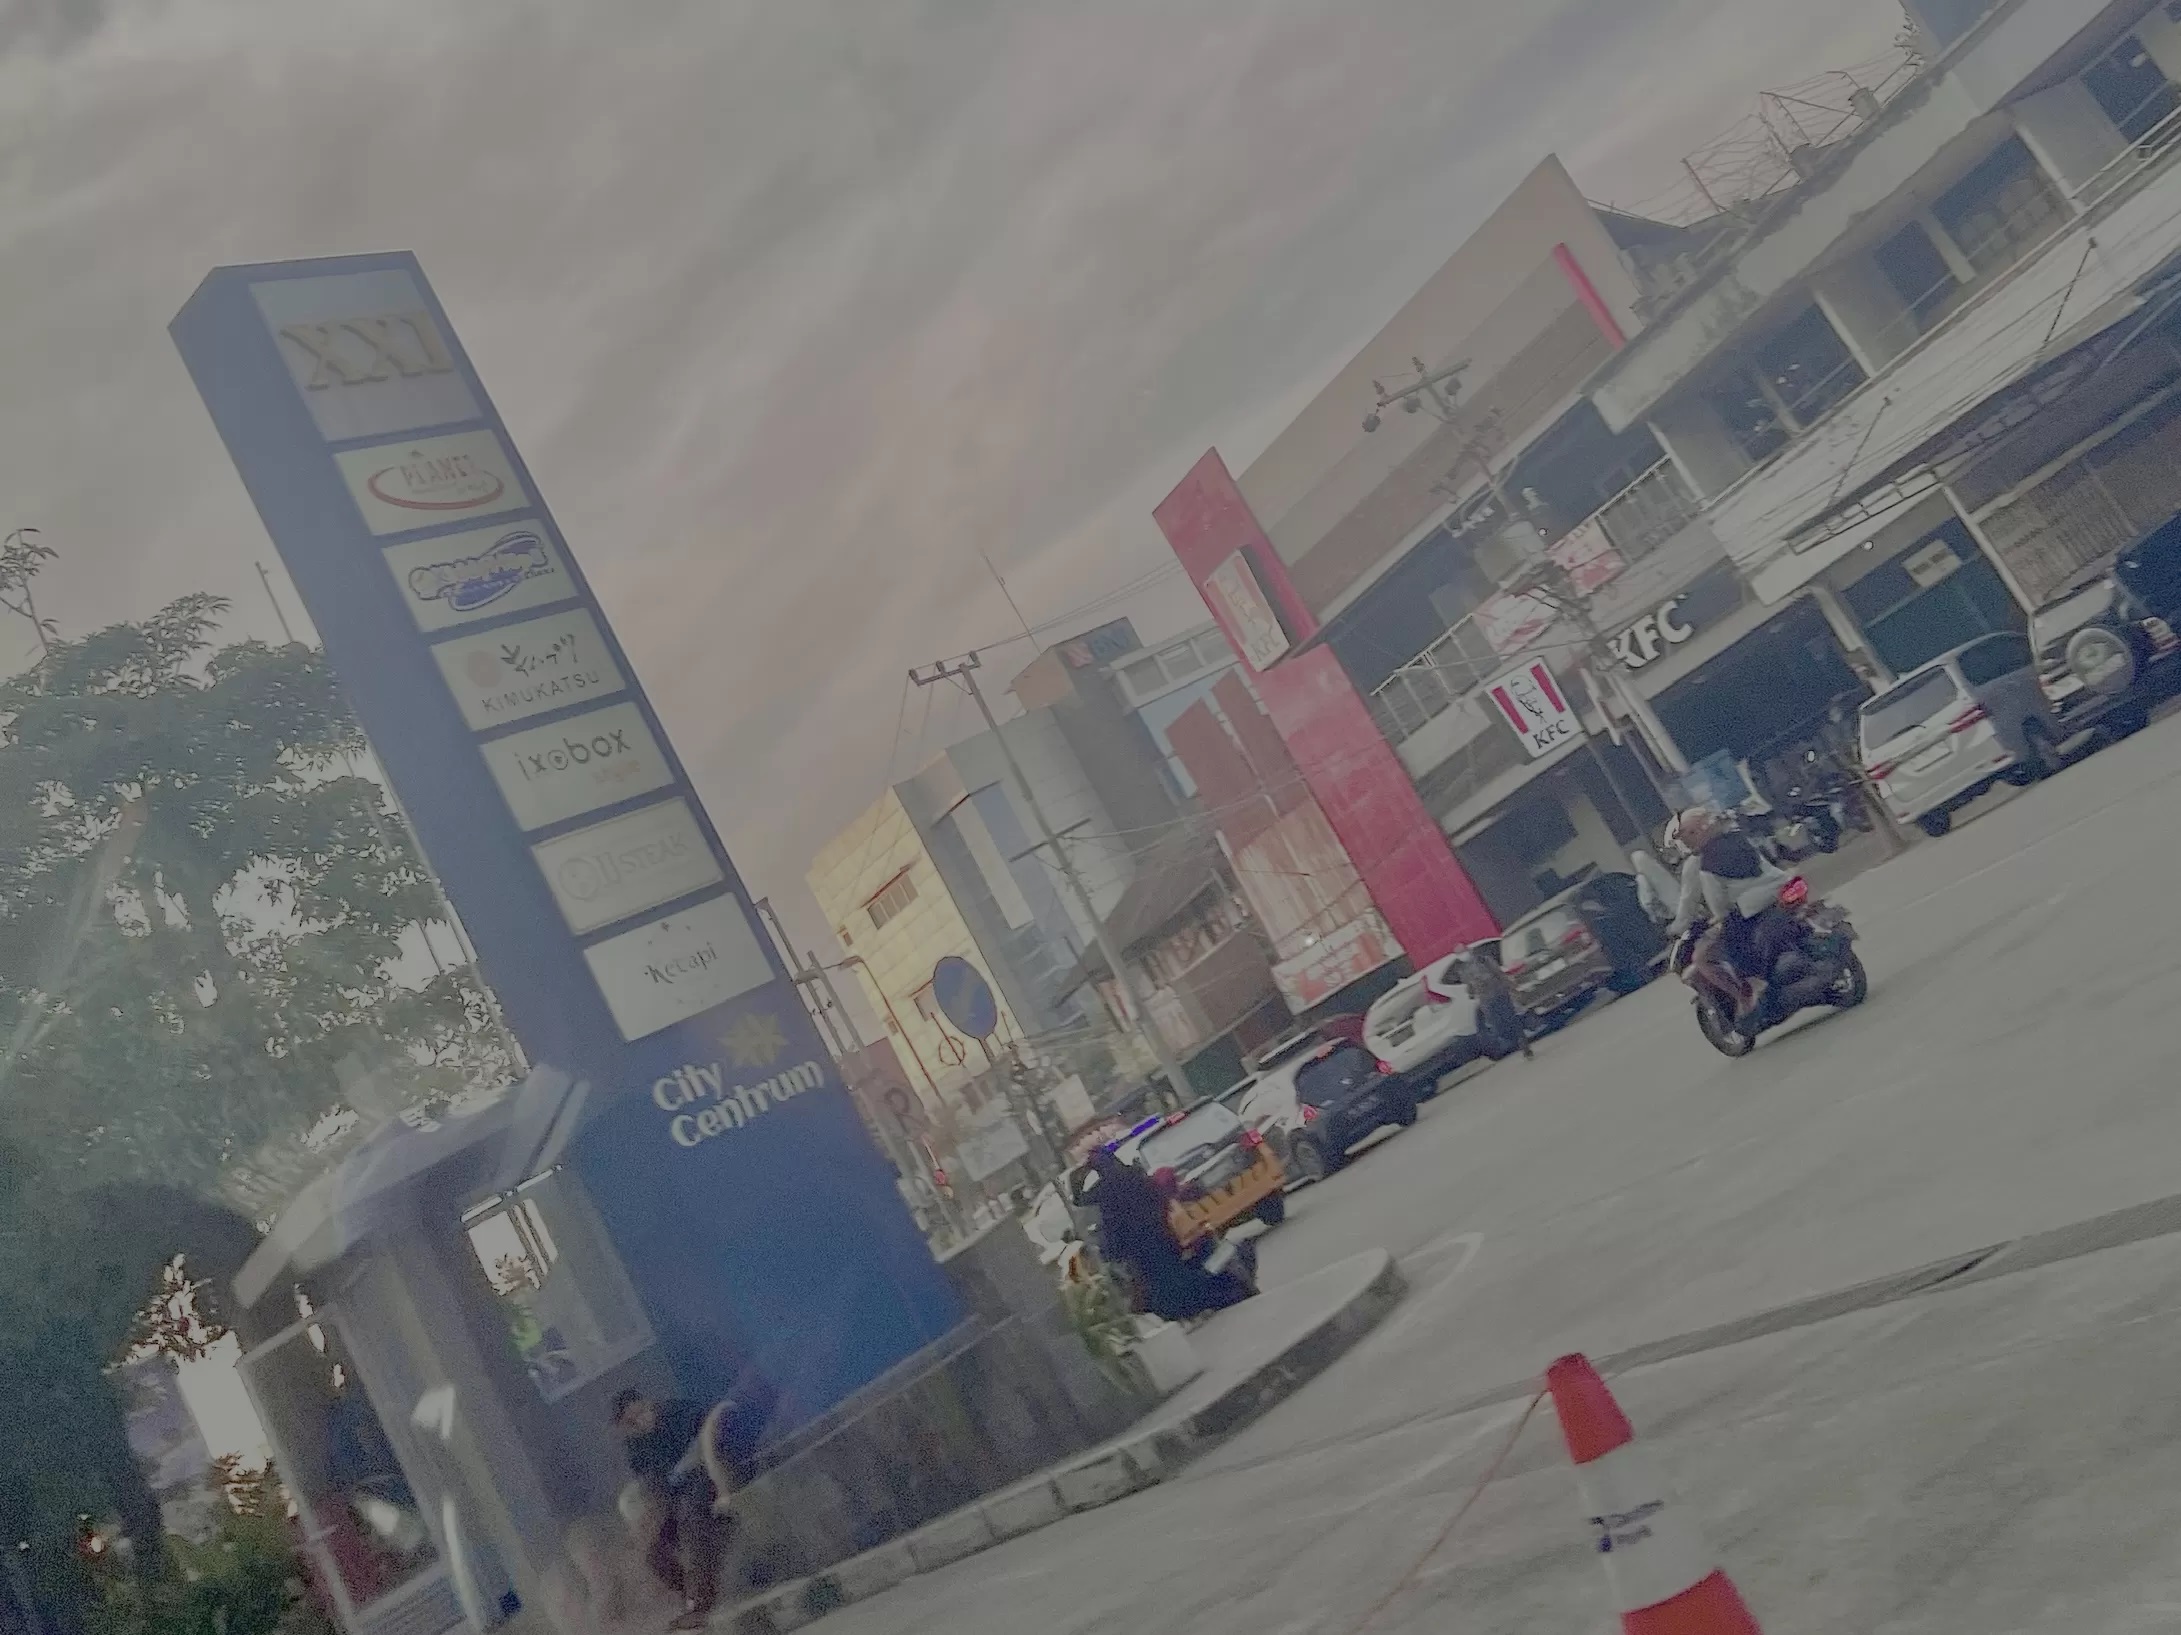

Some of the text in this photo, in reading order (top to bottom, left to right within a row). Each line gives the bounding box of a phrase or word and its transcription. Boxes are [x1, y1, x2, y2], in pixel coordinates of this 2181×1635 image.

[279, 312, 456, 391] XXI
[1606, 599, 1694, 668] KFC
[482, 671, 600, 712] KIMUKATSU
[1532, 718, 1570, 749] KFC
[653, 1062, 724, 1111] City
[671, 1061, 826, 1147] Centrum
